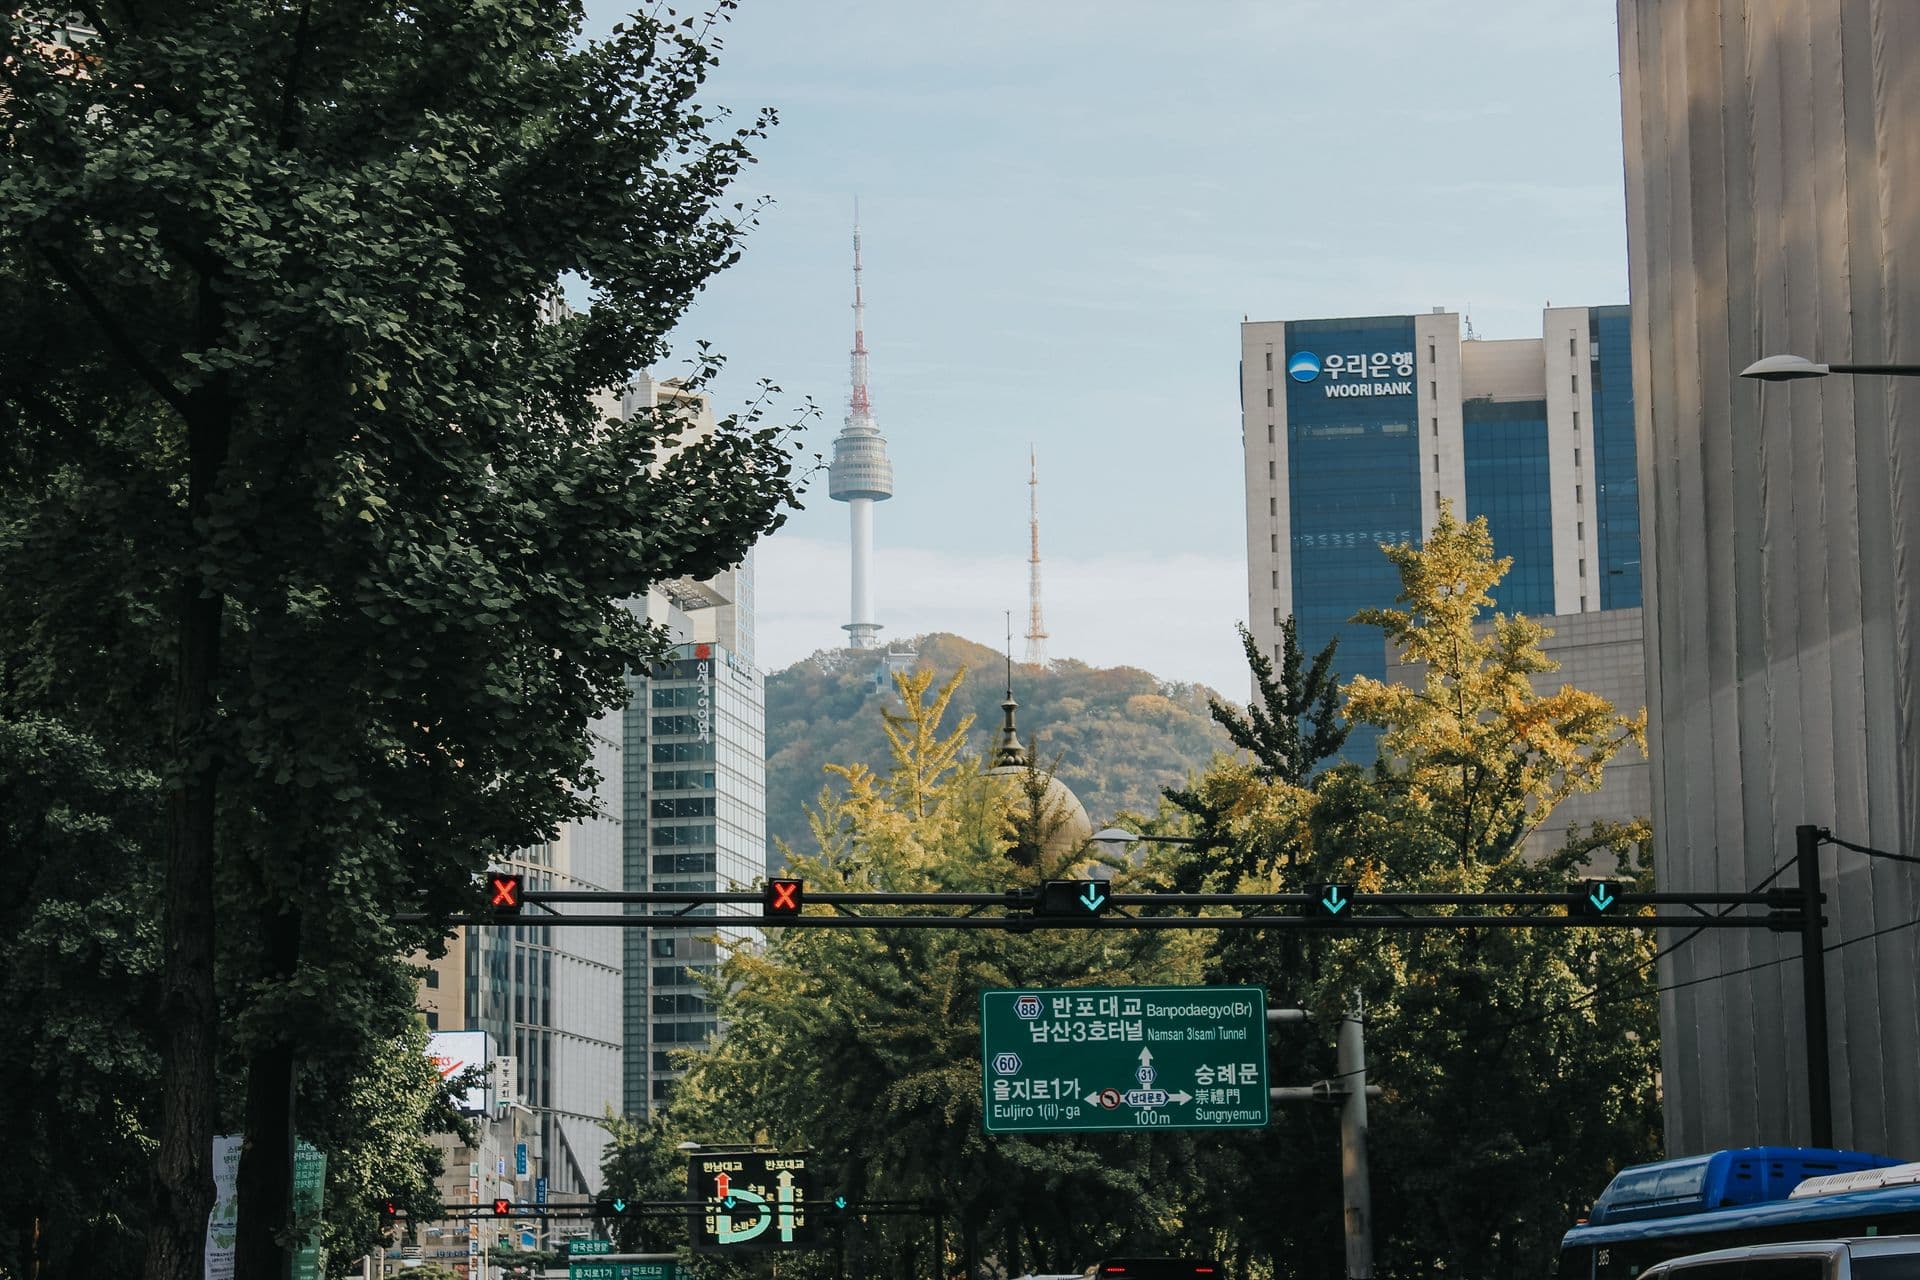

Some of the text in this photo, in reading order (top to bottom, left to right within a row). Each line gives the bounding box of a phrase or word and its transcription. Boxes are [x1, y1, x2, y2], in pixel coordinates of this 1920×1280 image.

[1323, 352, 1414, 380] 우리은행
[1325, 382, 1412, 398] WOORI BANK
[1021, 1004, 1038, 1016] 88
[1052, 995, 1143, 1018] 반포대교
[1146, 1002, 1253, 1020] Banpodaegyo(Br)
[1029, 1020, 1144, 1043] 남산3호터널
[1148, 1028, 1184, 1041] Namsan
[1219, 1026, 1247, 1040] Tunnel
[999, 1057, 1016, 1071] 60
[1140, 1068, 1153, 1081] 31
[1194, 1063, 1259, 1085] 숭례문
[993, 1078, 1081, 1101] 을지로1가
[1195, 1088, 1241, 1105] 崇禮門
[1131, 1092, 1164, 1104] 남대문로
[995, 1106, 1034, 1121] Euljiro
[703, 1161, 743, 1173] 한남대교
[765, 1159, 805, 1171] 반포대교
